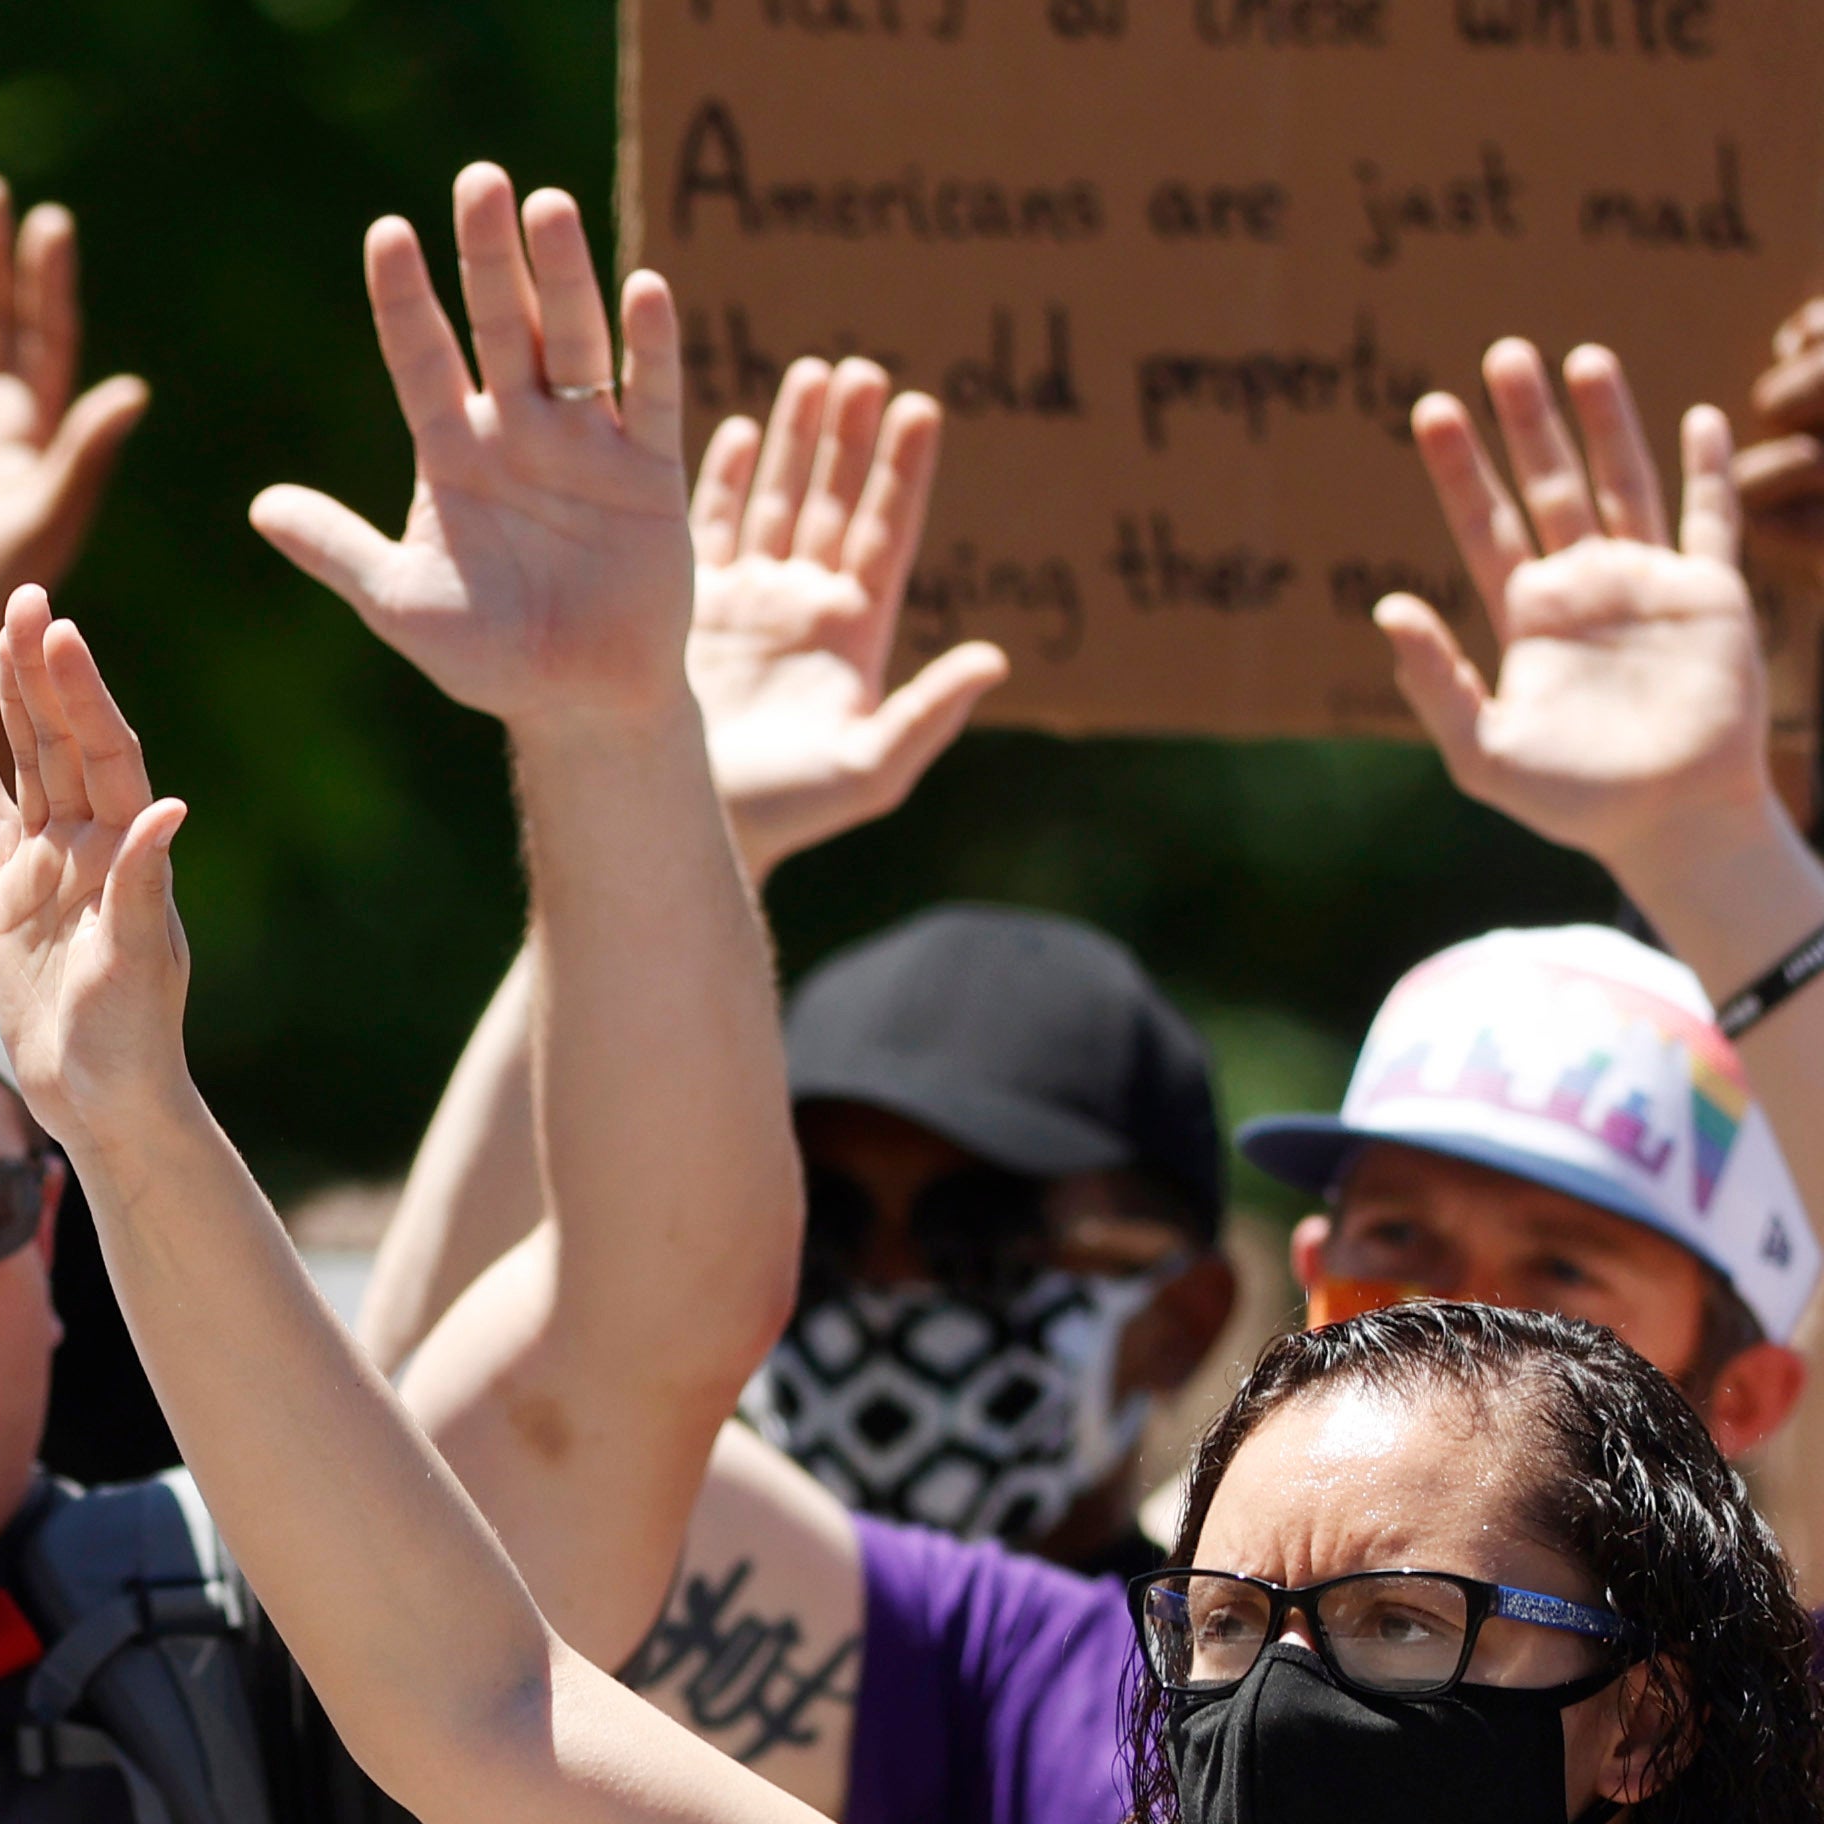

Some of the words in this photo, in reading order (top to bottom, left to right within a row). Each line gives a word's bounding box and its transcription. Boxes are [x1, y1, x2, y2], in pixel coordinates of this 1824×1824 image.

[670, 94, 1107, 245] Americans
[1147, 175, 1292, 244] are
[1350, 138, 1526, 268] just
[1578, 134, 1764, 254] mad
[940, 301, 1082, 420] old
